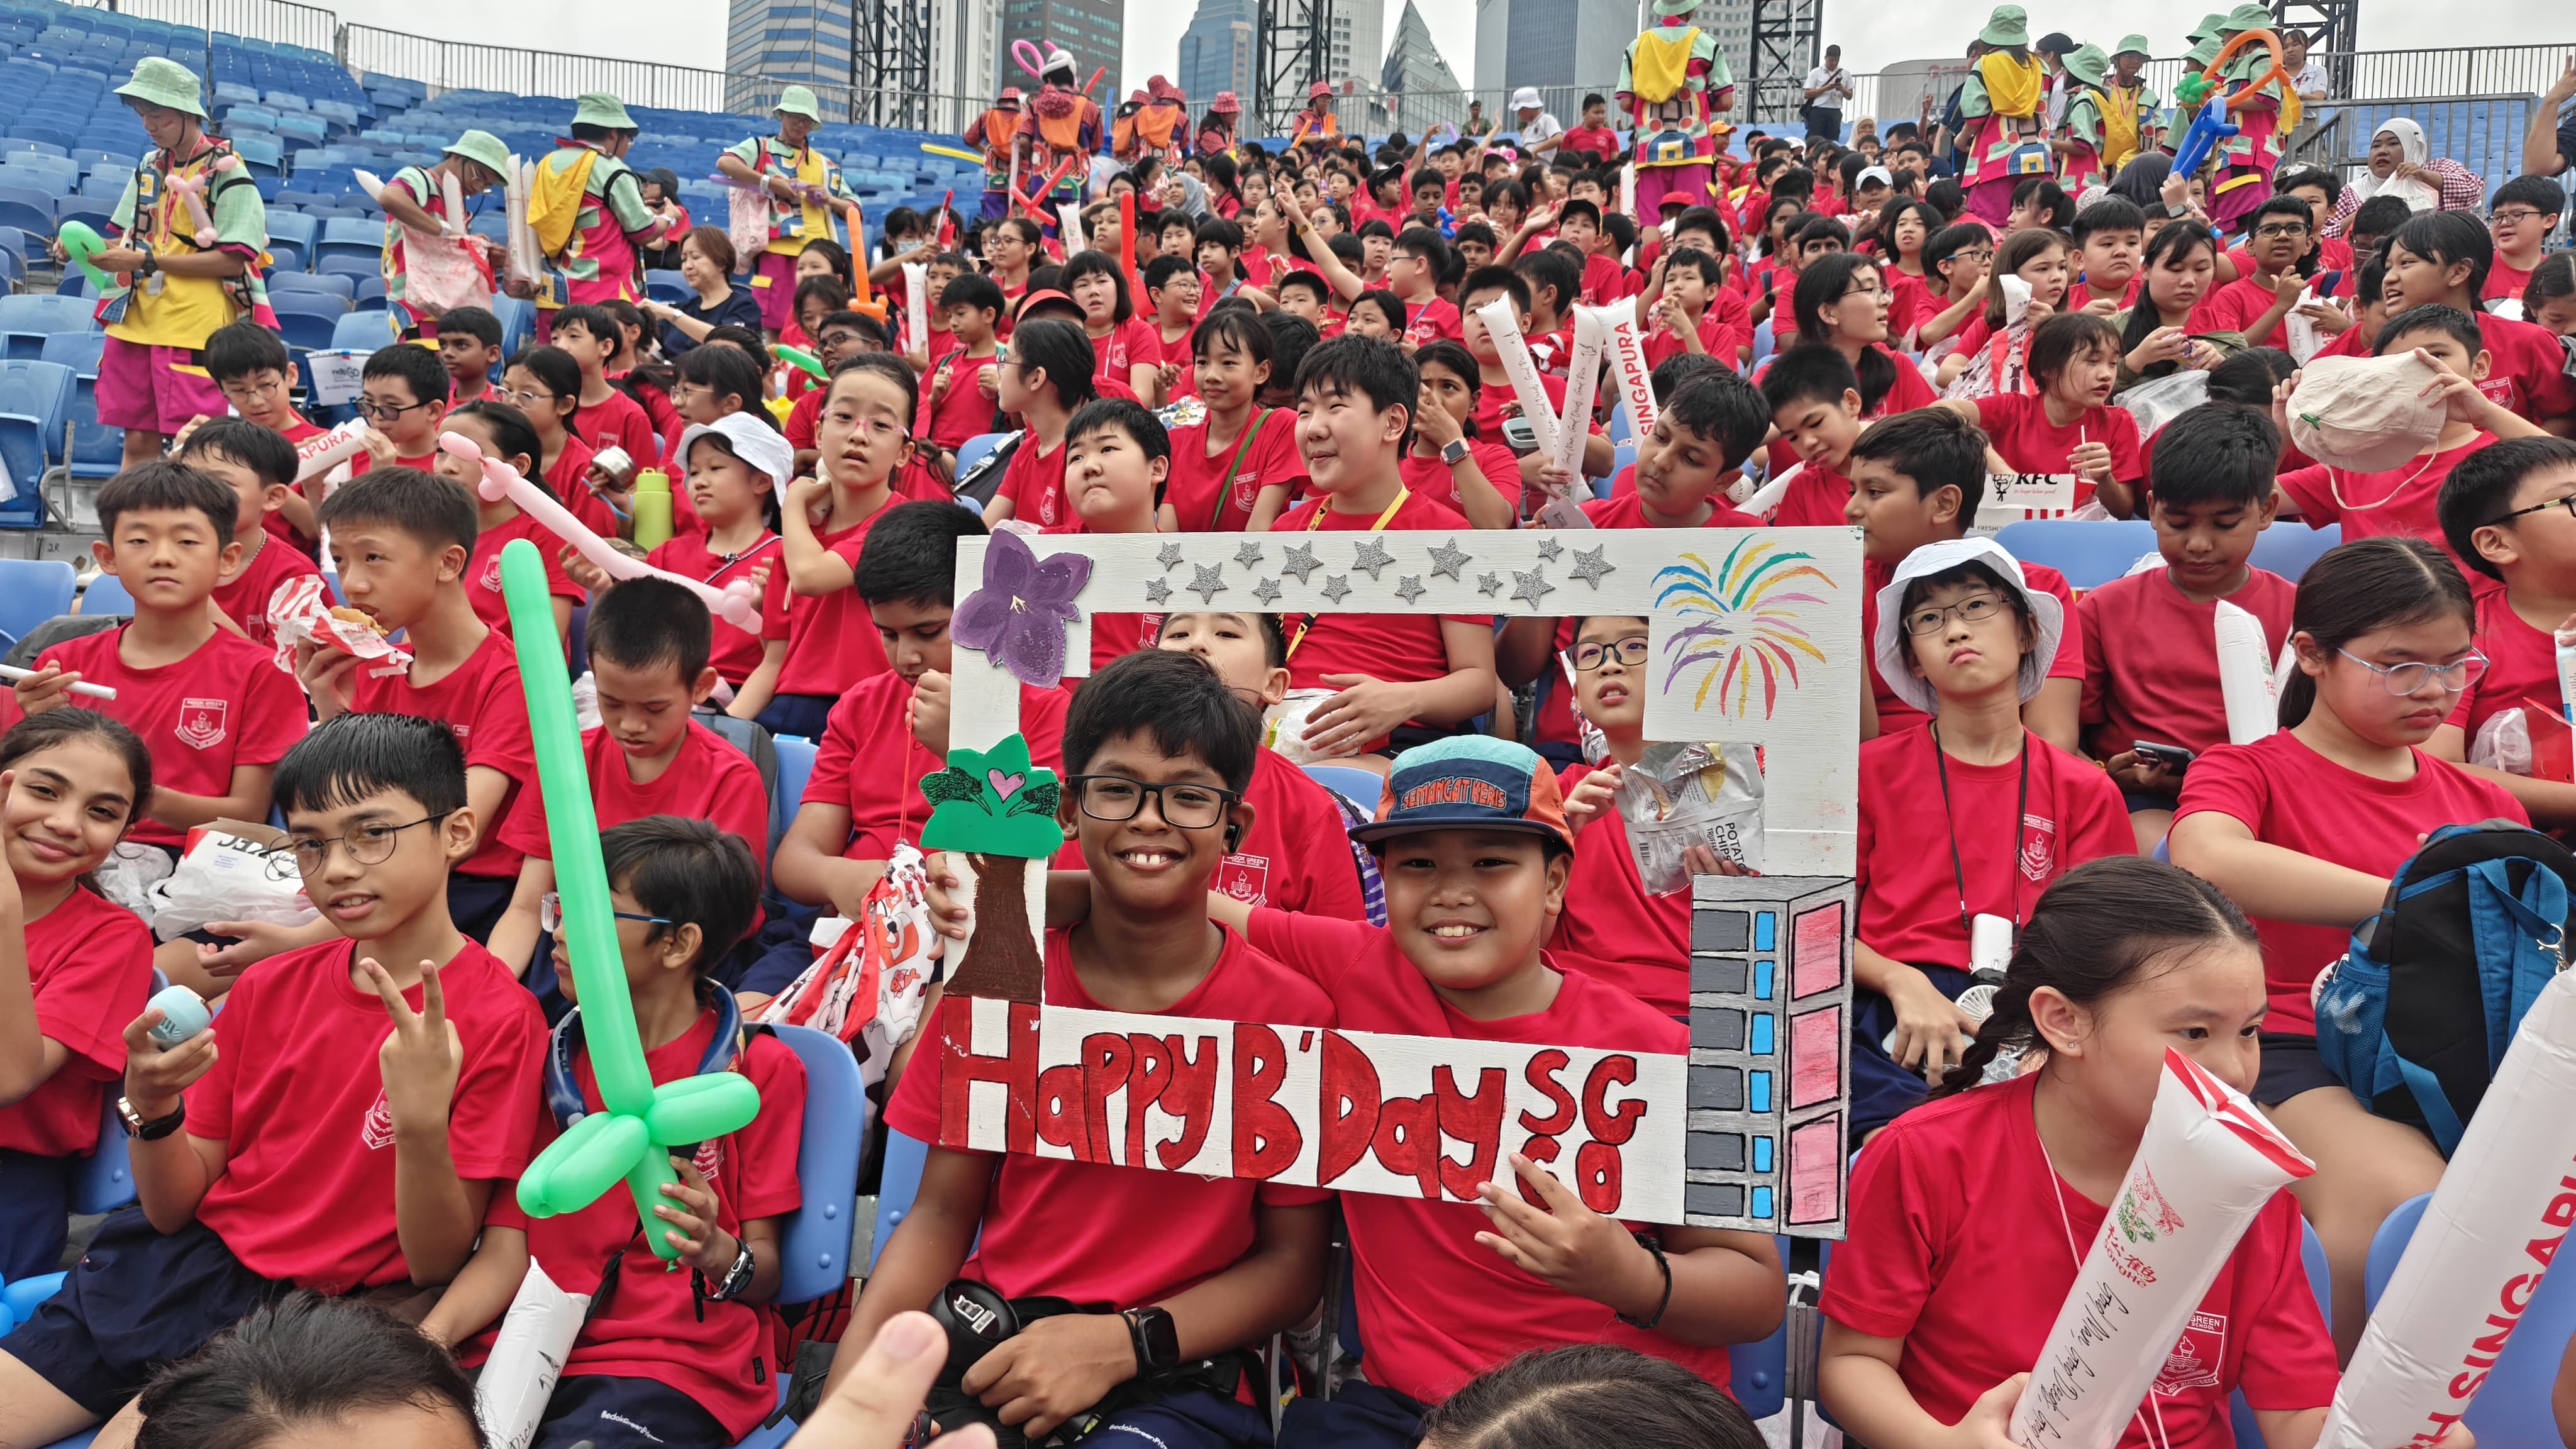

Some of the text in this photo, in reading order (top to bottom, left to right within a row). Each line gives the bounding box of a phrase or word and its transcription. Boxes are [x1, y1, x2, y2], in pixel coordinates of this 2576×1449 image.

[1614, 321, 1655, 436] SINGAPURA
[2015, 474, 2058, 485] KFC
[1401, 777, 1506, 810] SEMANGAT KERIS
[941, 996, 1507, 1201] Happy B'Day
[1518, 1048, 1648, 1146] SG
[2086, 1281, 2129, 1332] Good
[2055, 1345, 2095, 1393] Good
